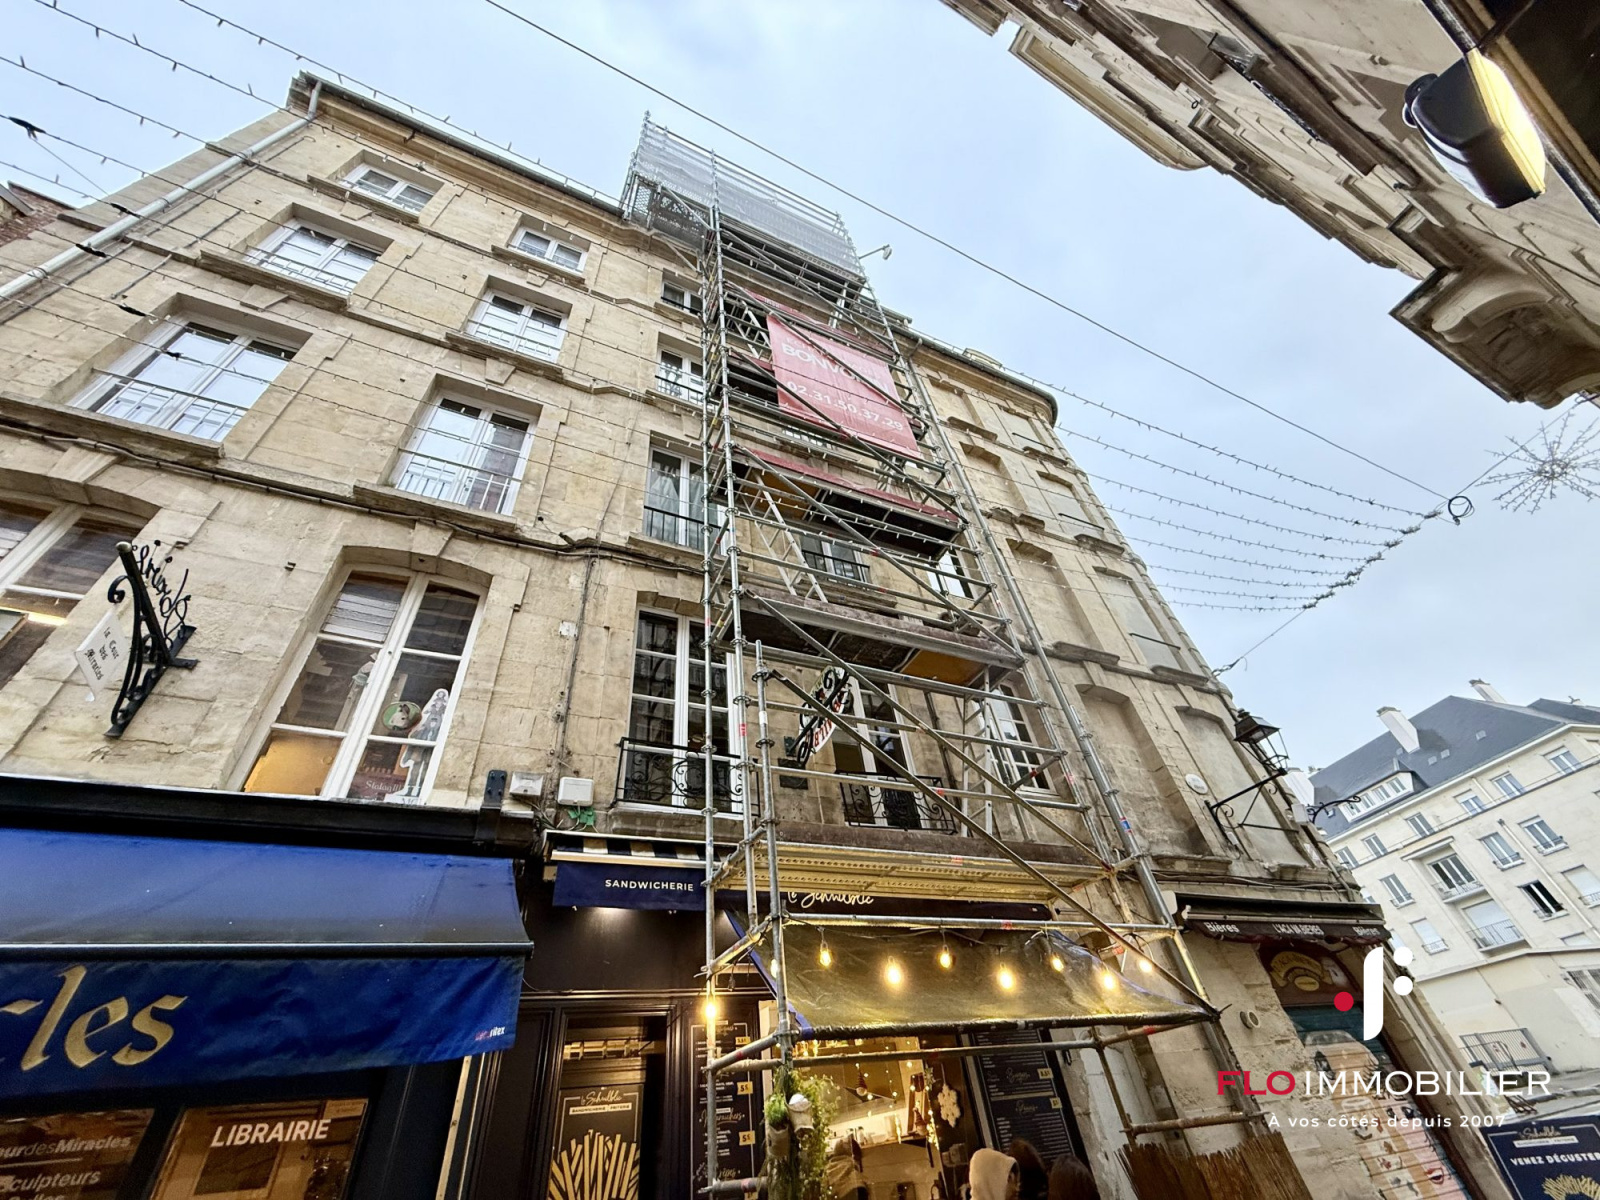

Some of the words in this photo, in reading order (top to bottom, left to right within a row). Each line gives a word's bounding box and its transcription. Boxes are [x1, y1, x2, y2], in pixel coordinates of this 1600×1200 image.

[781, 342, 890, 395] BONVON
[604, 879, 694, 892] SANDWICHERIE
[1204, 921, 1240, 934] Bières
[1352, 926, 1381, 936] Bières
[210, 1118, 332, 1148] LIBRAIRIE
[1510, 1155, 1545, 1167] VENEZ
